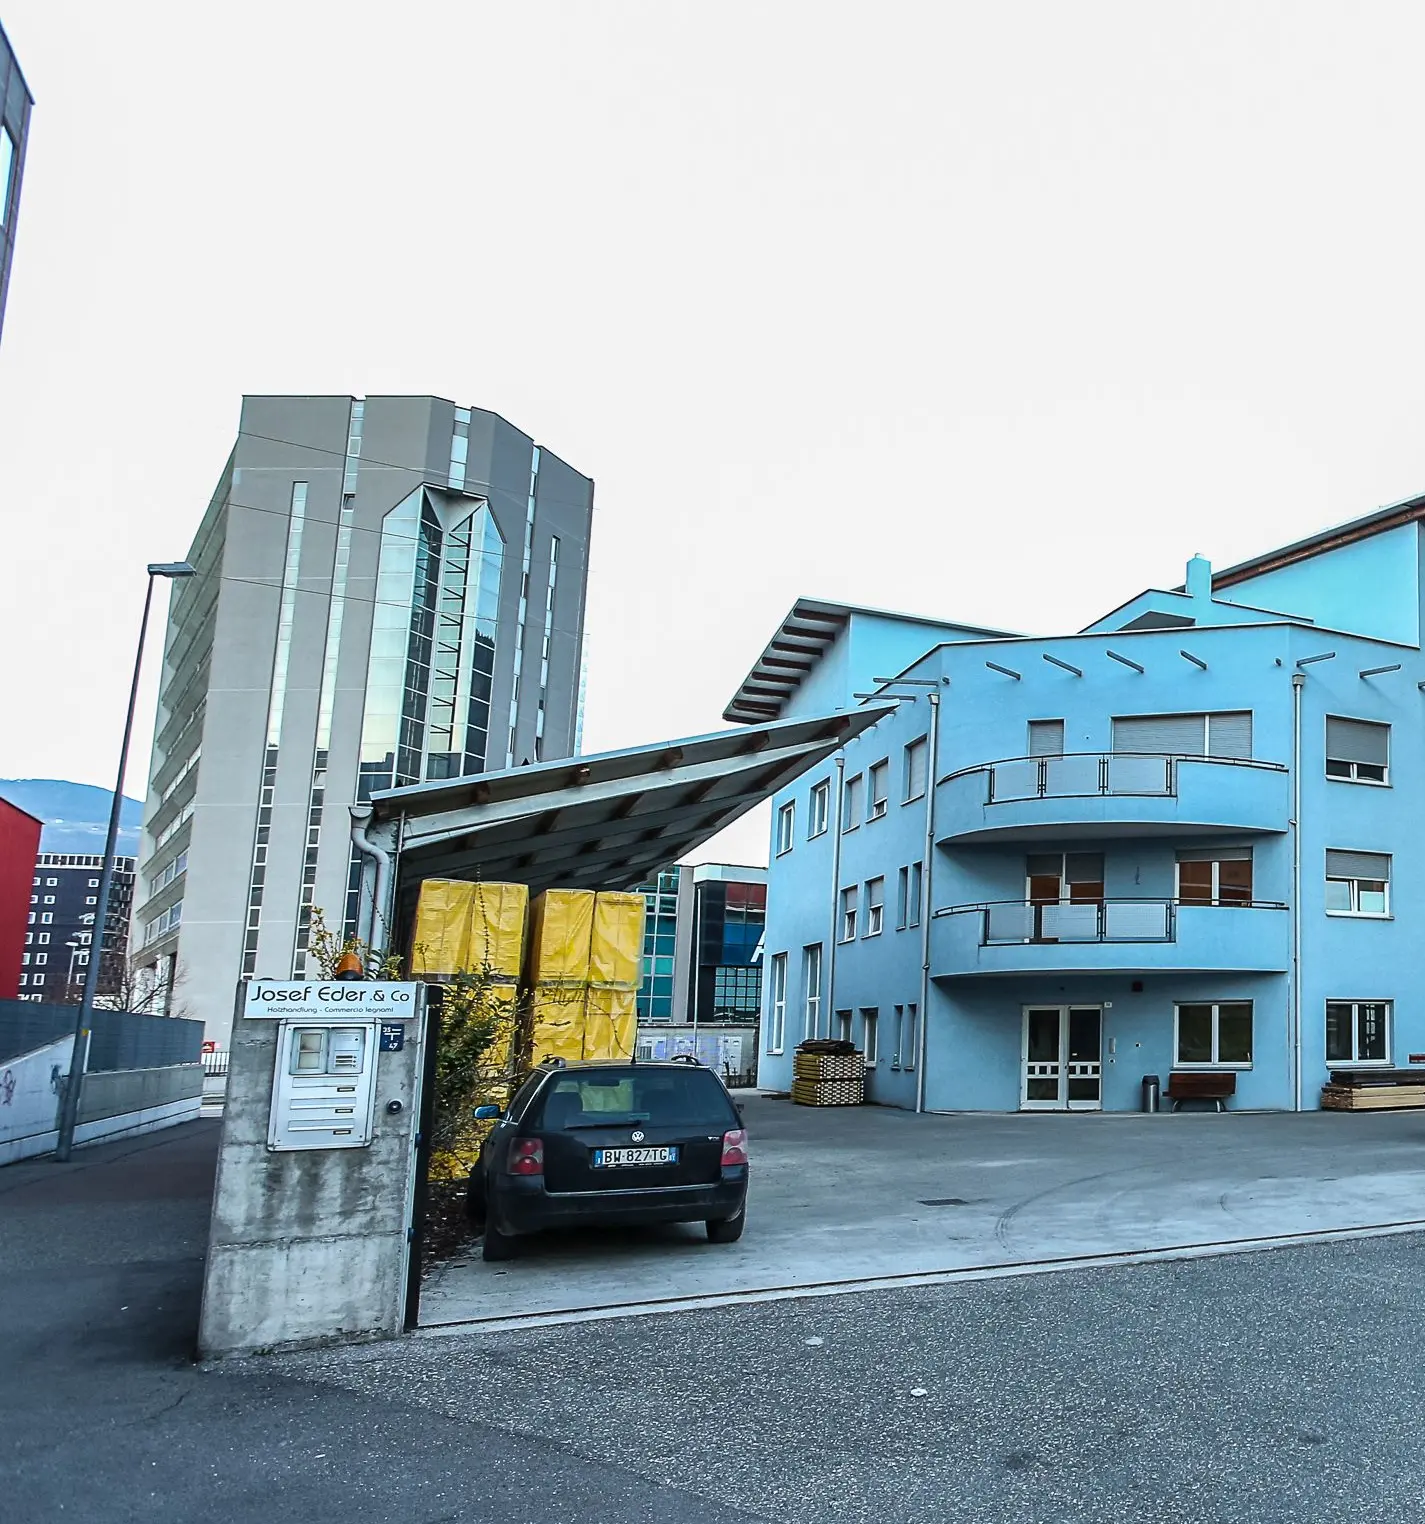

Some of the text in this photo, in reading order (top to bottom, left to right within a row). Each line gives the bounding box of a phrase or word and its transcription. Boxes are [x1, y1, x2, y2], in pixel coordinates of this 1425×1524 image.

[251, 985, 312, 1002] Josef
[317, 986, 367, 1002] Eder
[390, 990, 410, 1002] Co
[267, 1006, 318, 1014] Holzhandlung
